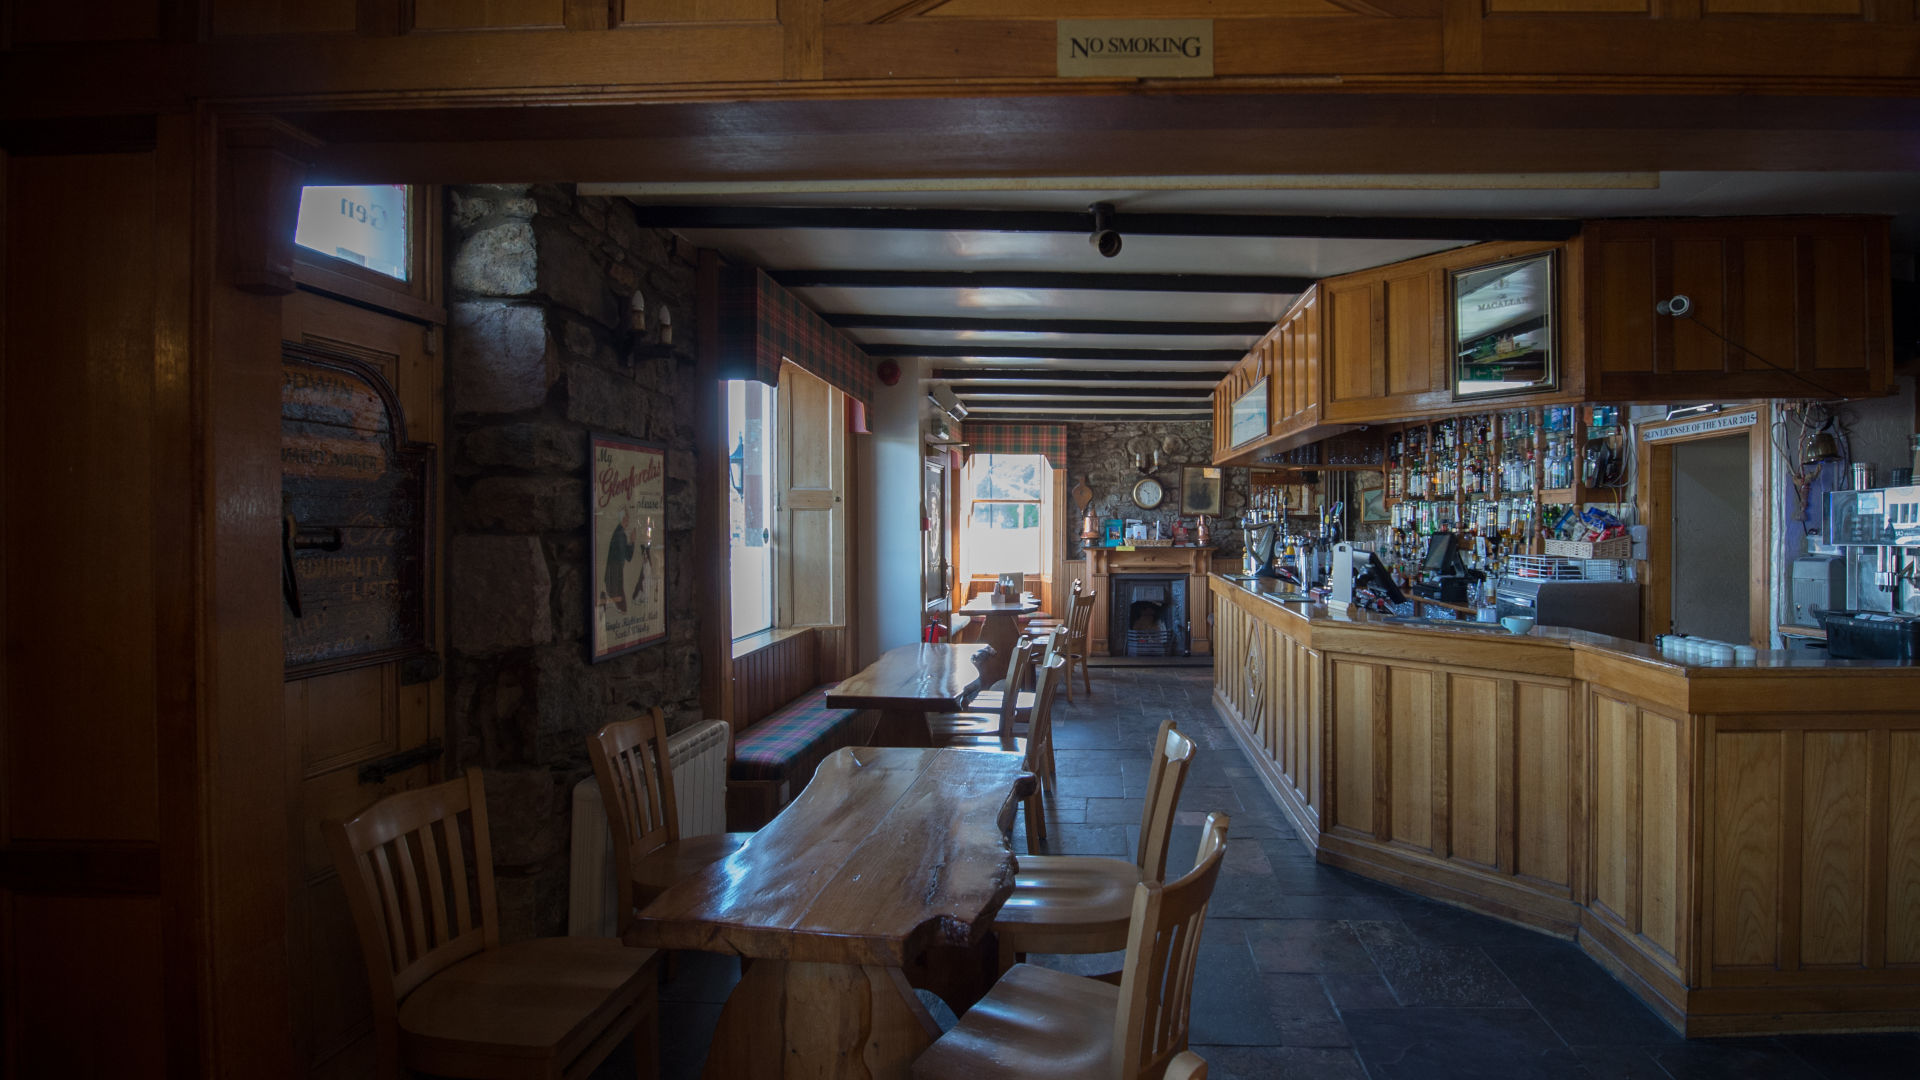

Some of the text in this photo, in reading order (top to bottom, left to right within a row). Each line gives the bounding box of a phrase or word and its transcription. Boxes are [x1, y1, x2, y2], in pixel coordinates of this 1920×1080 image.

[1070, 36, 1202, 58] NO SMOKING
[1478, 296, 1529, 310] MACALLAN
[1660, 424, 1690, 437] LICENSEE
[1691, 423, 1701, 432] OF
[1703, 419, 1717, 430] THE
[1717, 416, 1738, 428] YEAR
[1739, 413, 1755, 424] 2015
